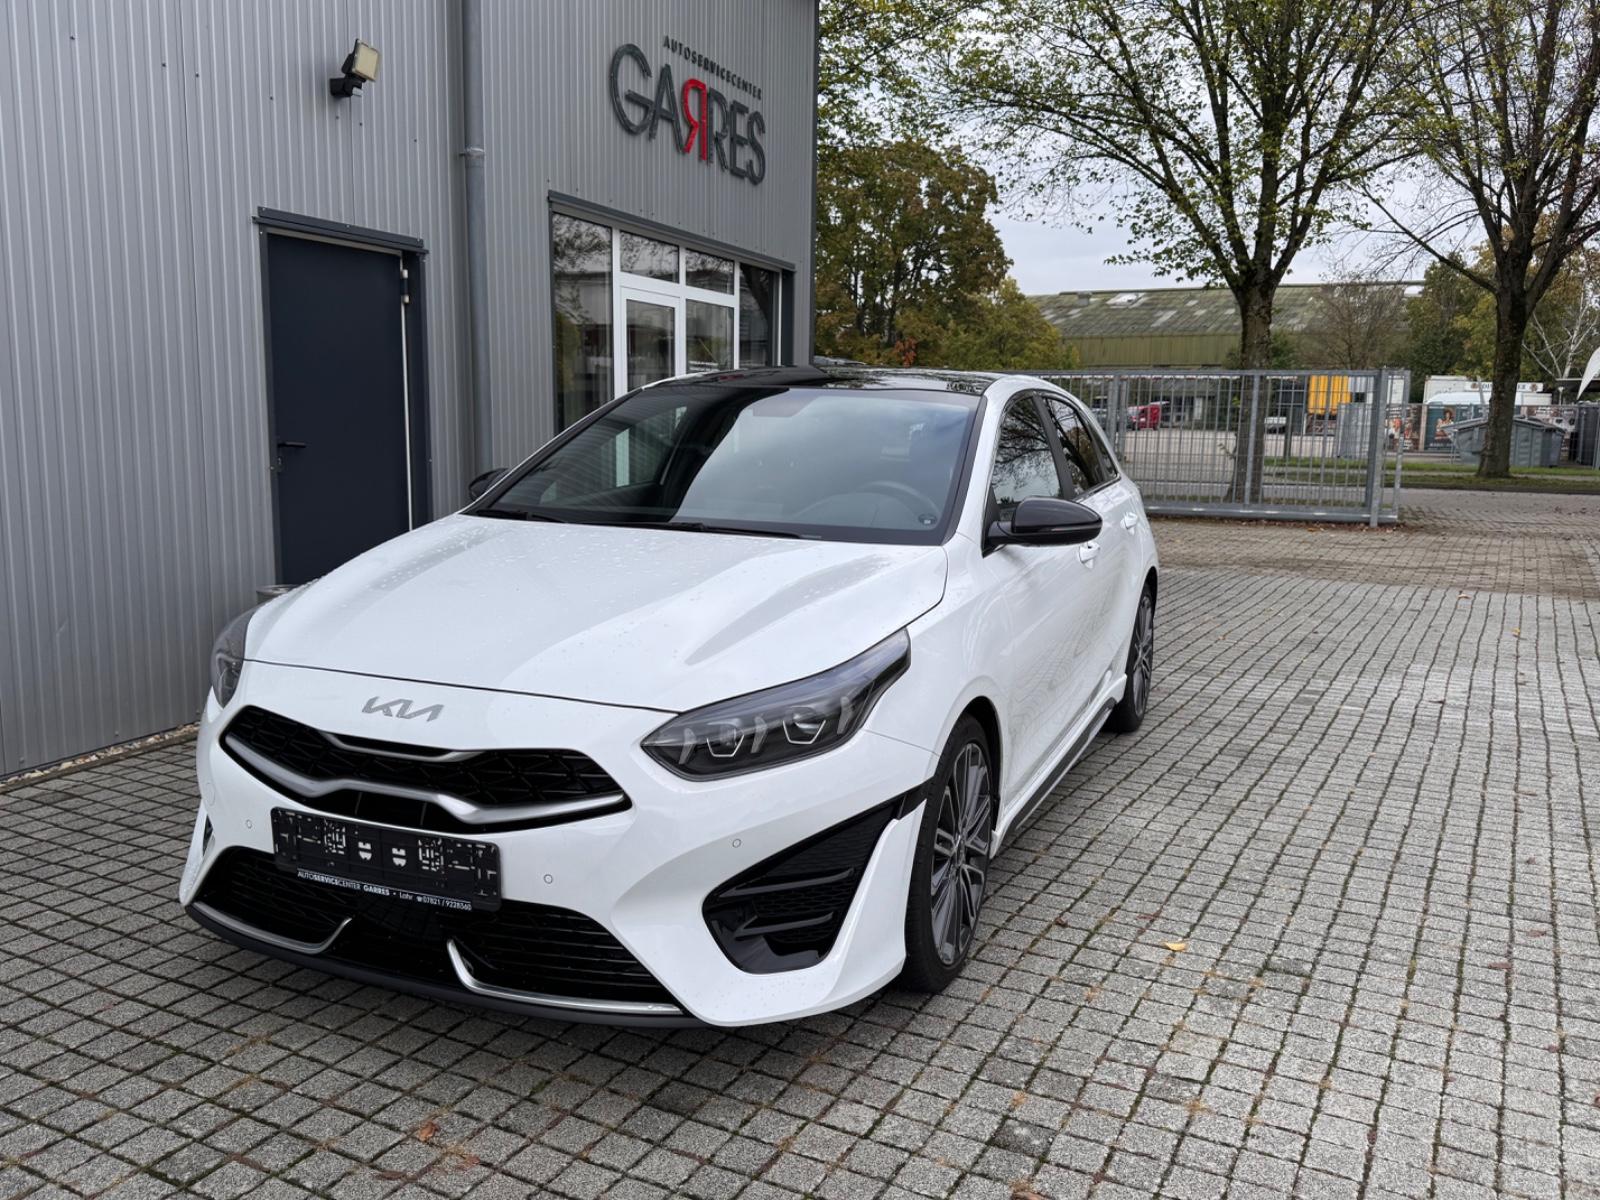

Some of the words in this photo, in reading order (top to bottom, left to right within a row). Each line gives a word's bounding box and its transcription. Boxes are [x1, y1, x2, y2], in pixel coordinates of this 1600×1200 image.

[663, 35, 762, 100] AUTOSERVICECENTER
[609, 43, 766, 186] GARRES
[361, 696, 444, 722] KIA
[297, 871, 361, 890] AUTOSERVICECENTER
[363, 884, 390, 896] GARRES
